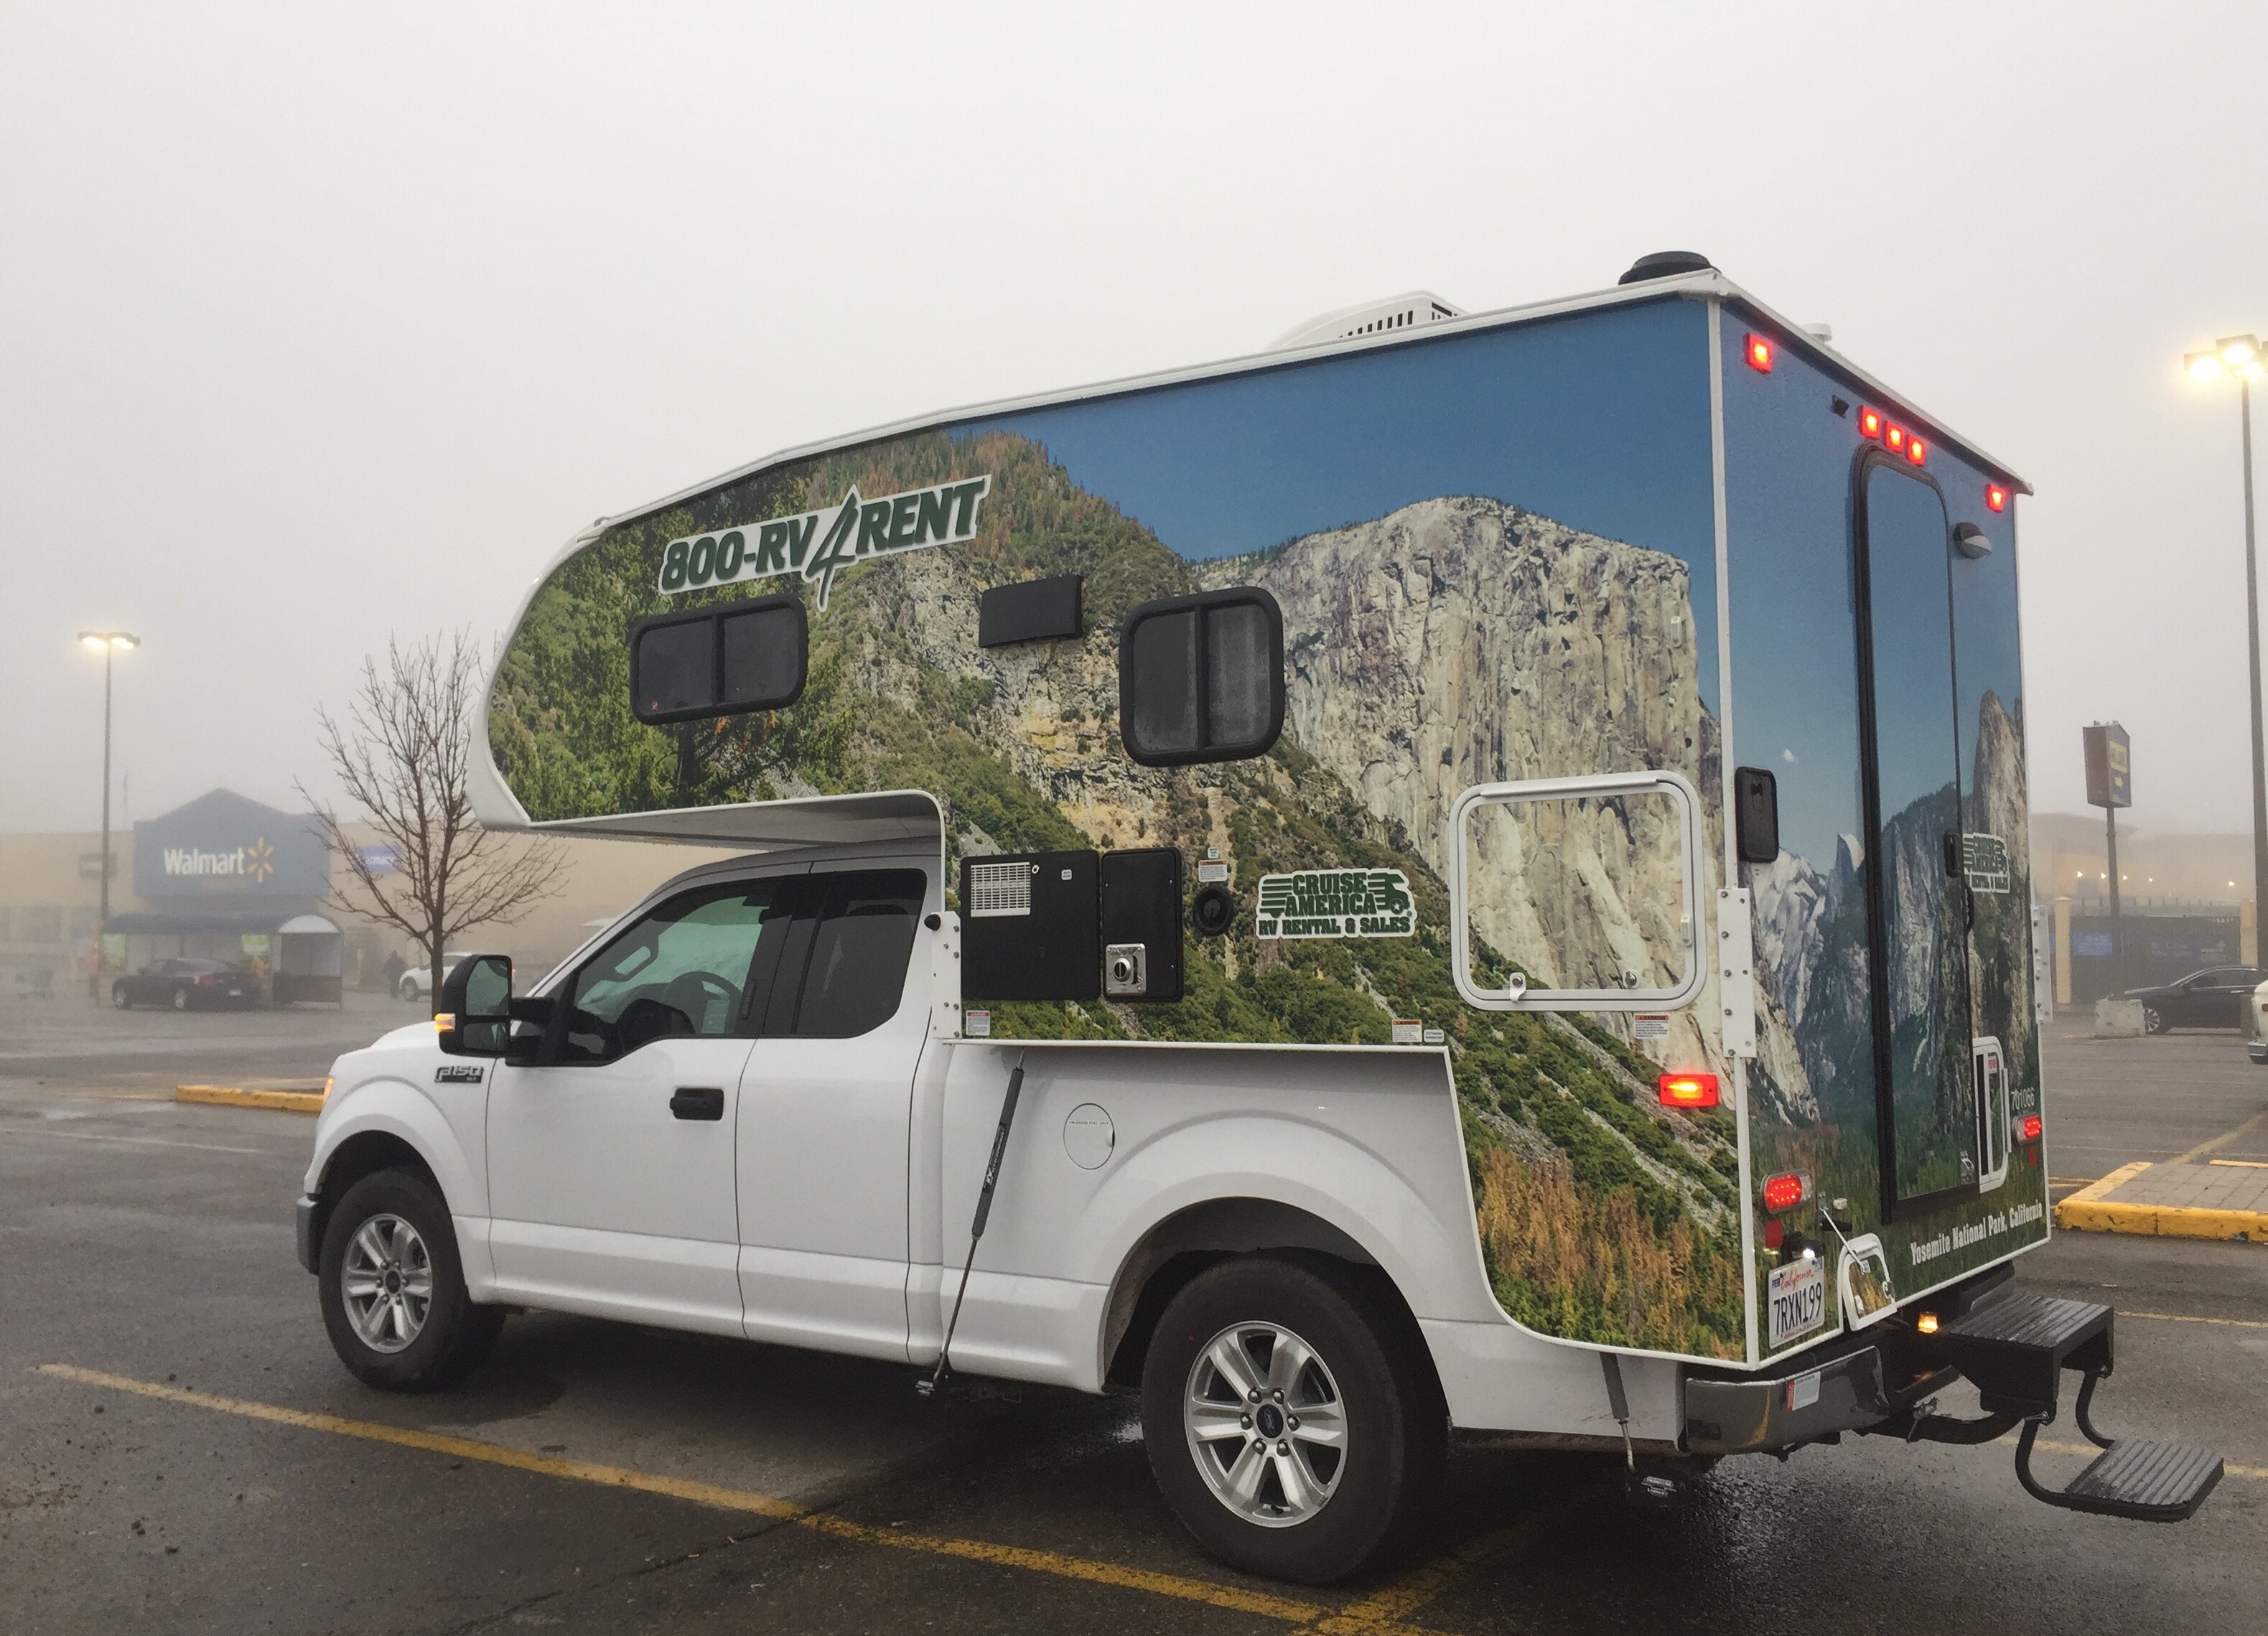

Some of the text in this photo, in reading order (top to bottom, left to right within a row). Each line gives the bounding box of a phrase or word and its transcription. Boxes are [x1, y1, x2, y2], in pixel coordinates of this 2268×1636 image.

[164, 847, 245, 875] Walmart
[1292, 872, 1368, 896] CRUISE
[1284, 893, 1377, 917] AMERICA
[1259, 917, 1411, 935] RV RENTAL & SALES
[1910, 1199, 2043, 1266] Yosemite National Park, California
[1773, 1281, 1822, 1336] 7RXN199
